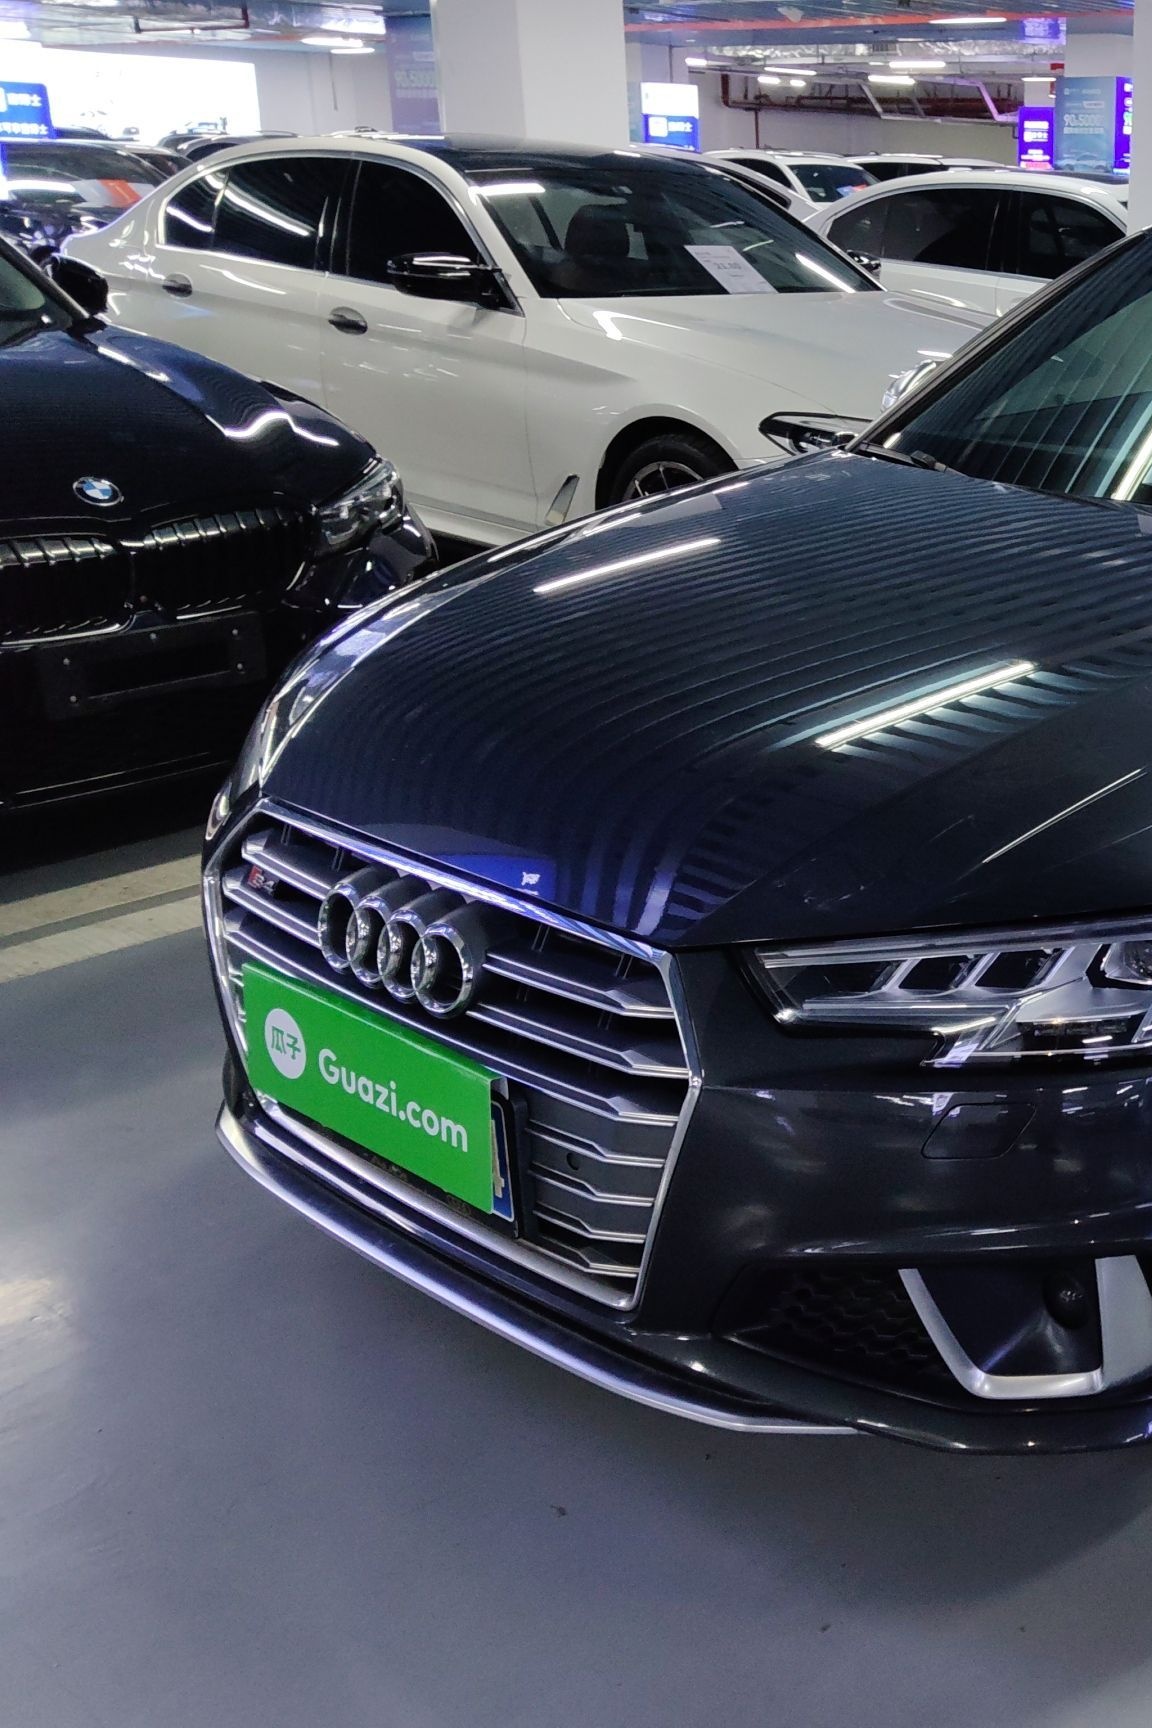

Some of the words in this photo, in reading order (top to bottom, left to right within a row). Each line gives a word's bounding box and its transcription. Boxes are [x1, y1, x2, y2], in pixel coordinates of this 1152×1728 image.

[247, 864, 276, 896] S4
[271, 1025, 301, 1060] 瓜子
[318, 1048, 468, 1152] Guazi.com
